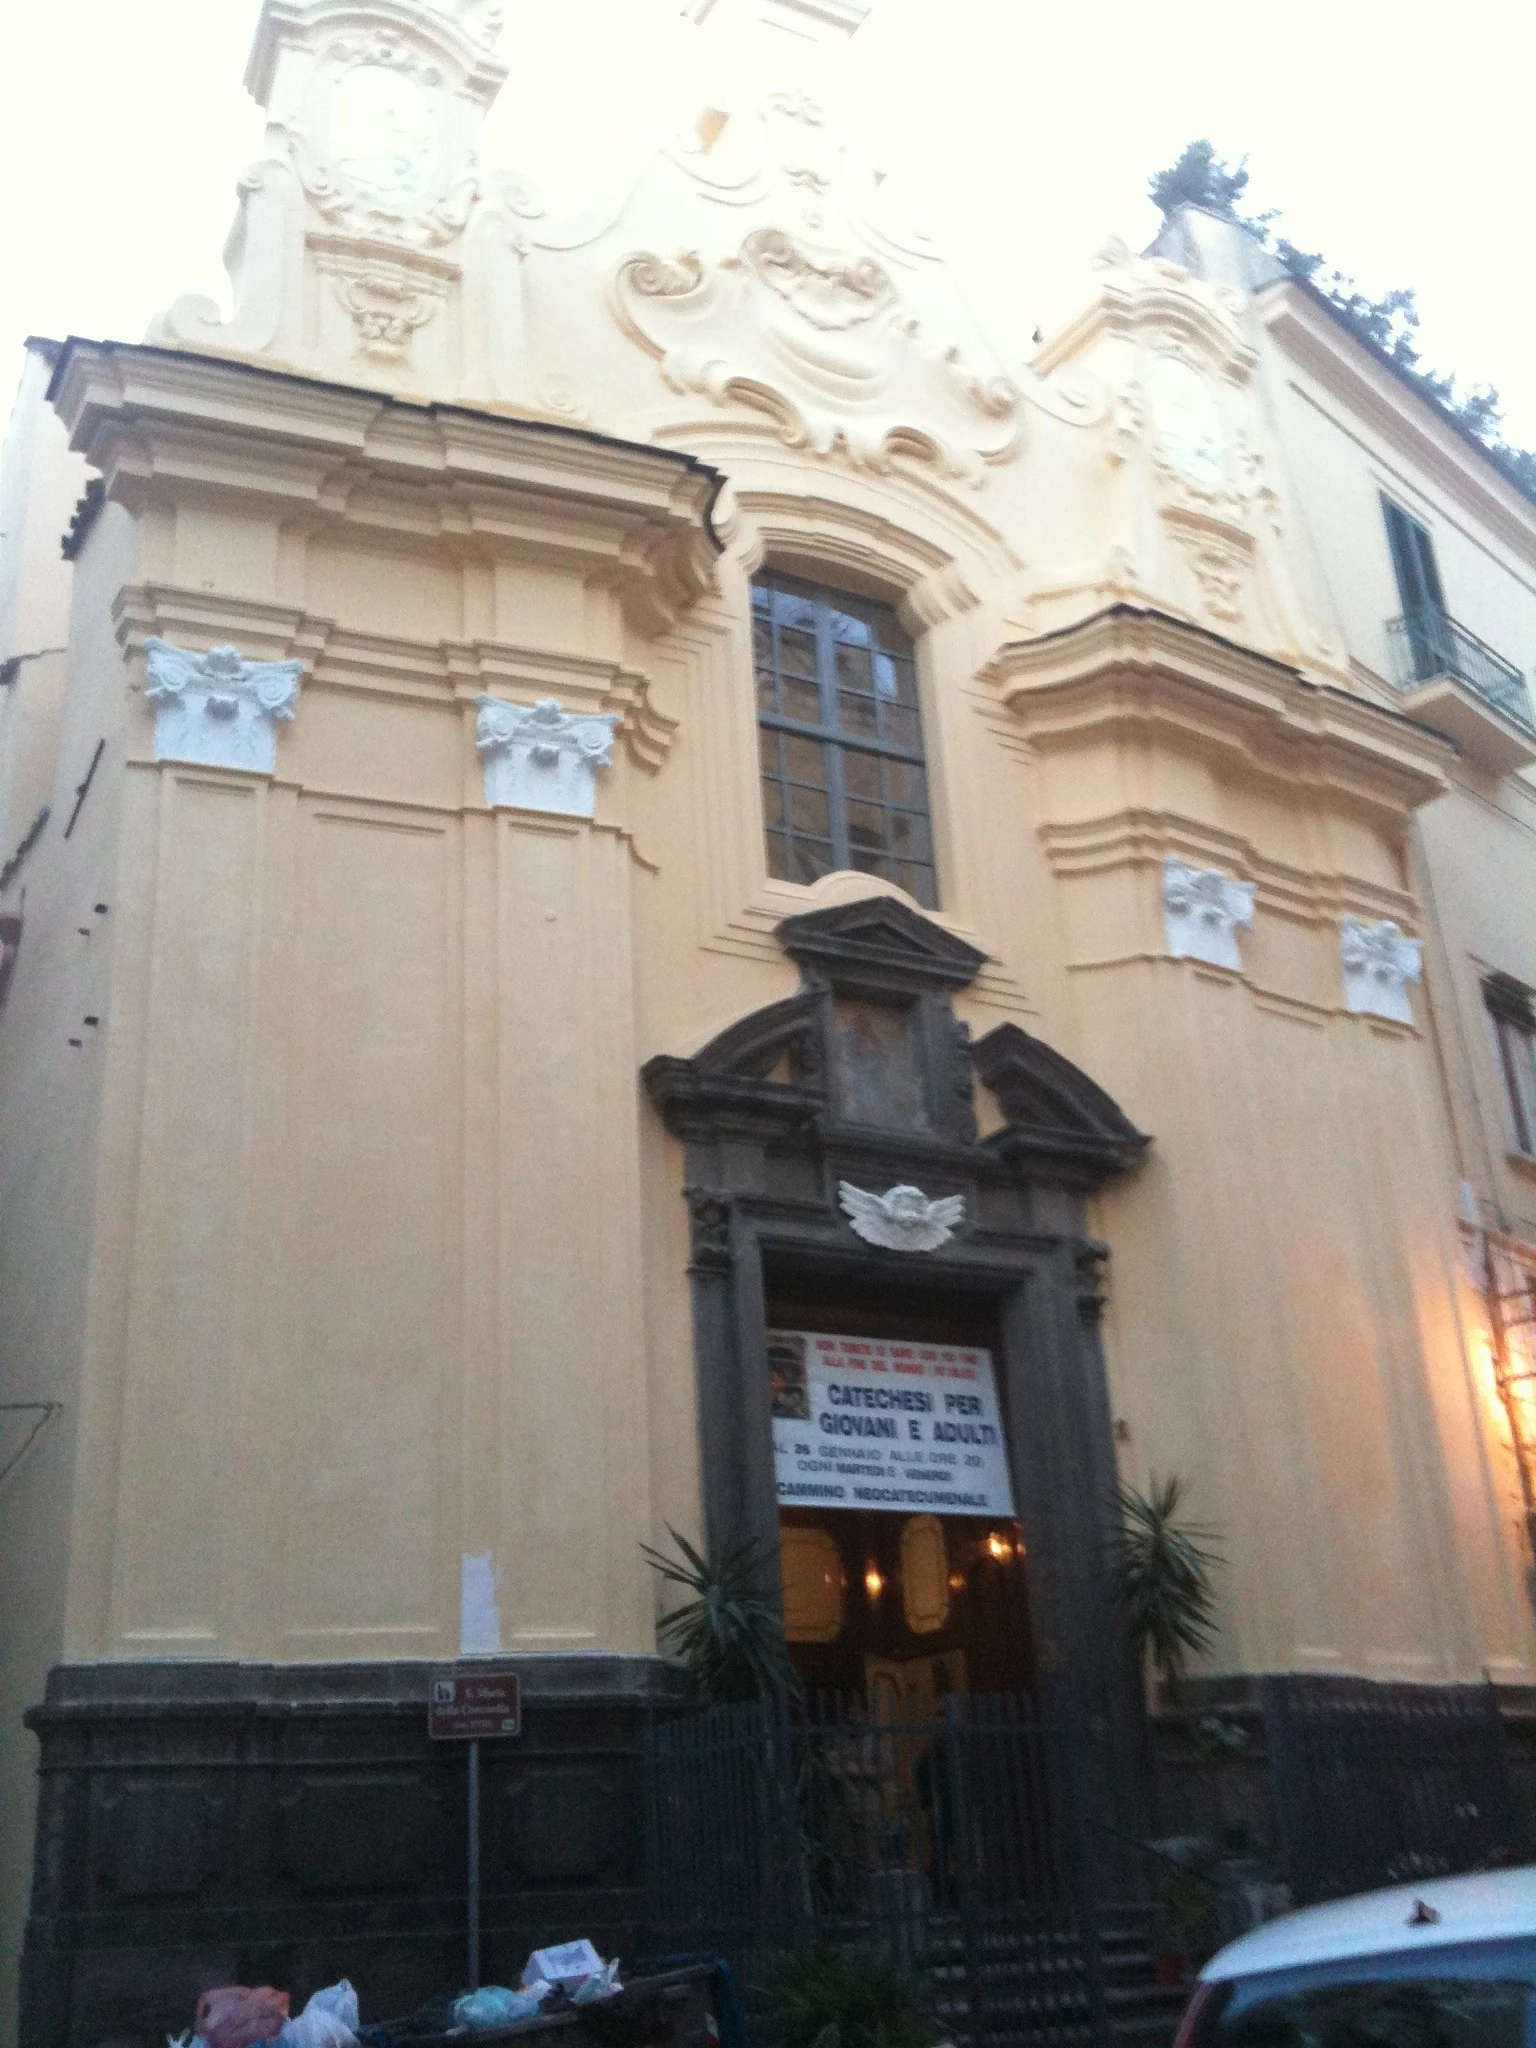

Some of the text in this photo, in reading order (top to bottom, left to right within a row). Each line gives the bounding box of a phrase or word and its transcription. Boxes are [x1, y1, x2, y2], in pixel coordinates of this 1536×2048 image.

[827, 1384, 983, 1417] CATECHESI PER
[818, 1412, 997, 1445] GIOVANI E ADULTI
[797, 1459, 832, 1472] OGNI
[818, 1445, 882, 1461] GENNAIO
[889, 1449, 924, 1463] ALLE
[928, 1452, 957, 1465] ORE
[776, 1481, 989, 1507] CAMMINO NEOCATECUMENALE
